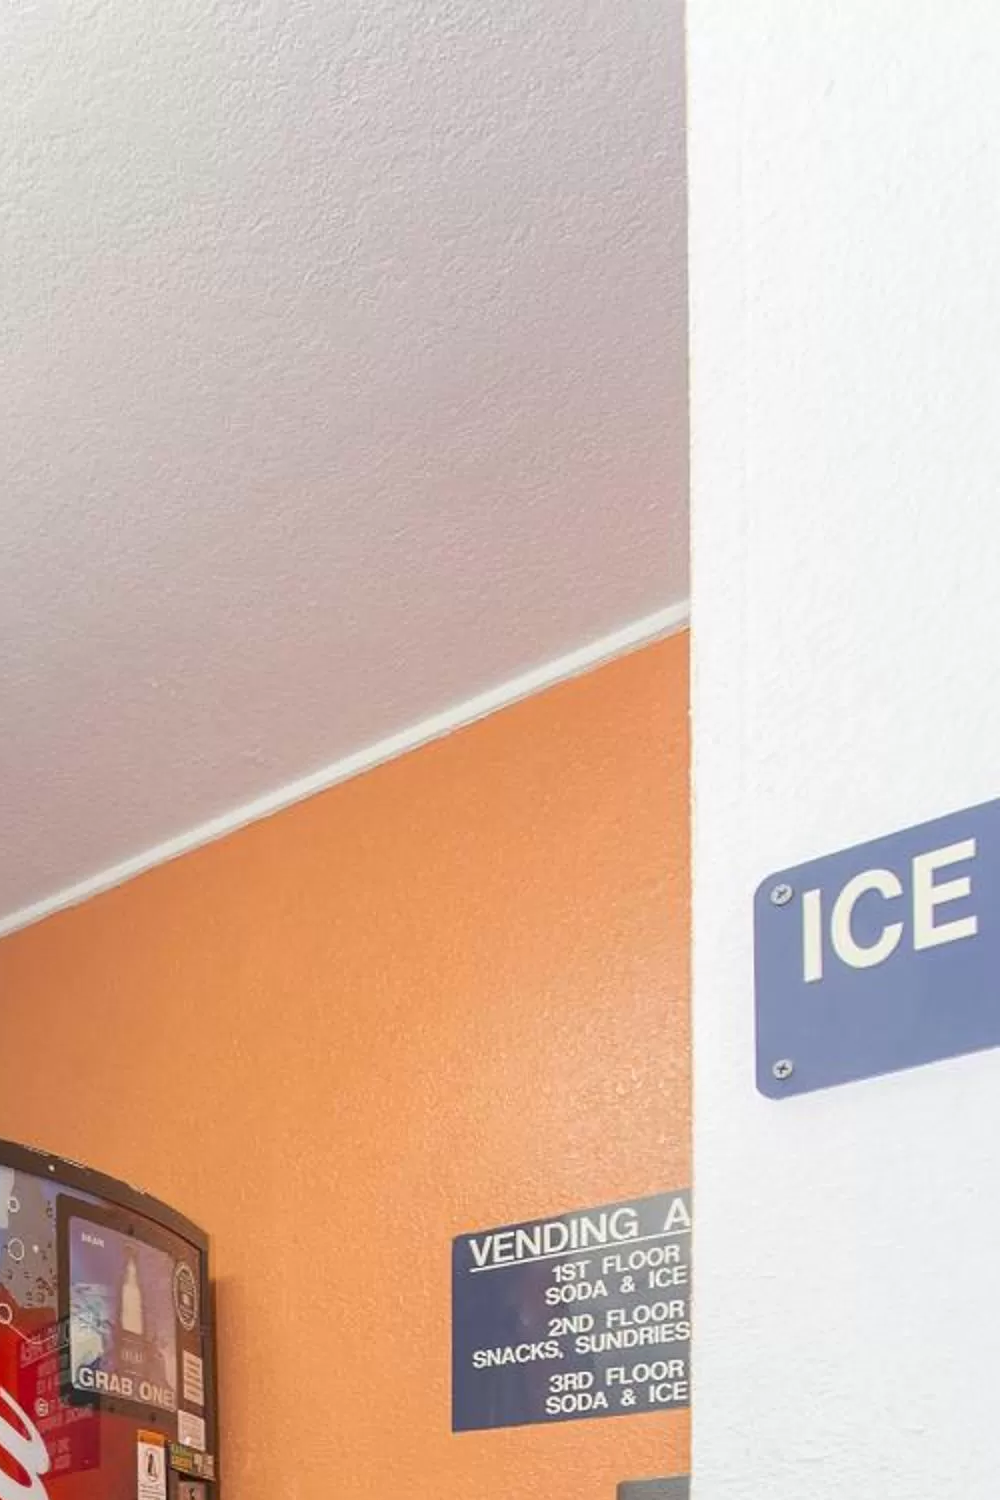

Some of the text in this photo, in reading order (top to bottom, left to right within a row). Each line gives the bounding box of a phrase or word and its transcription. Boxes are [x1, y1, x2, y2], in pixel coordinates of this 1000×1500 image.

[802, 838, 978, 983] ICE
[469, 1207, 639, 1267] VENDING
[552, 1244, 681, 1283] 1ST FLOOR
[545, 1265, 688, 1305] SODA & ICE
[548, 1300, 685, 1337] 2ND FLOOR
[575, 1321, 691, 1354] SUNDRIES
[79, 1366, 133, 1397] GRAB
[549, 1359, 685, 1393] 3RD FLOOR
[545, 1381, 688, 1415] SODA & ICE
